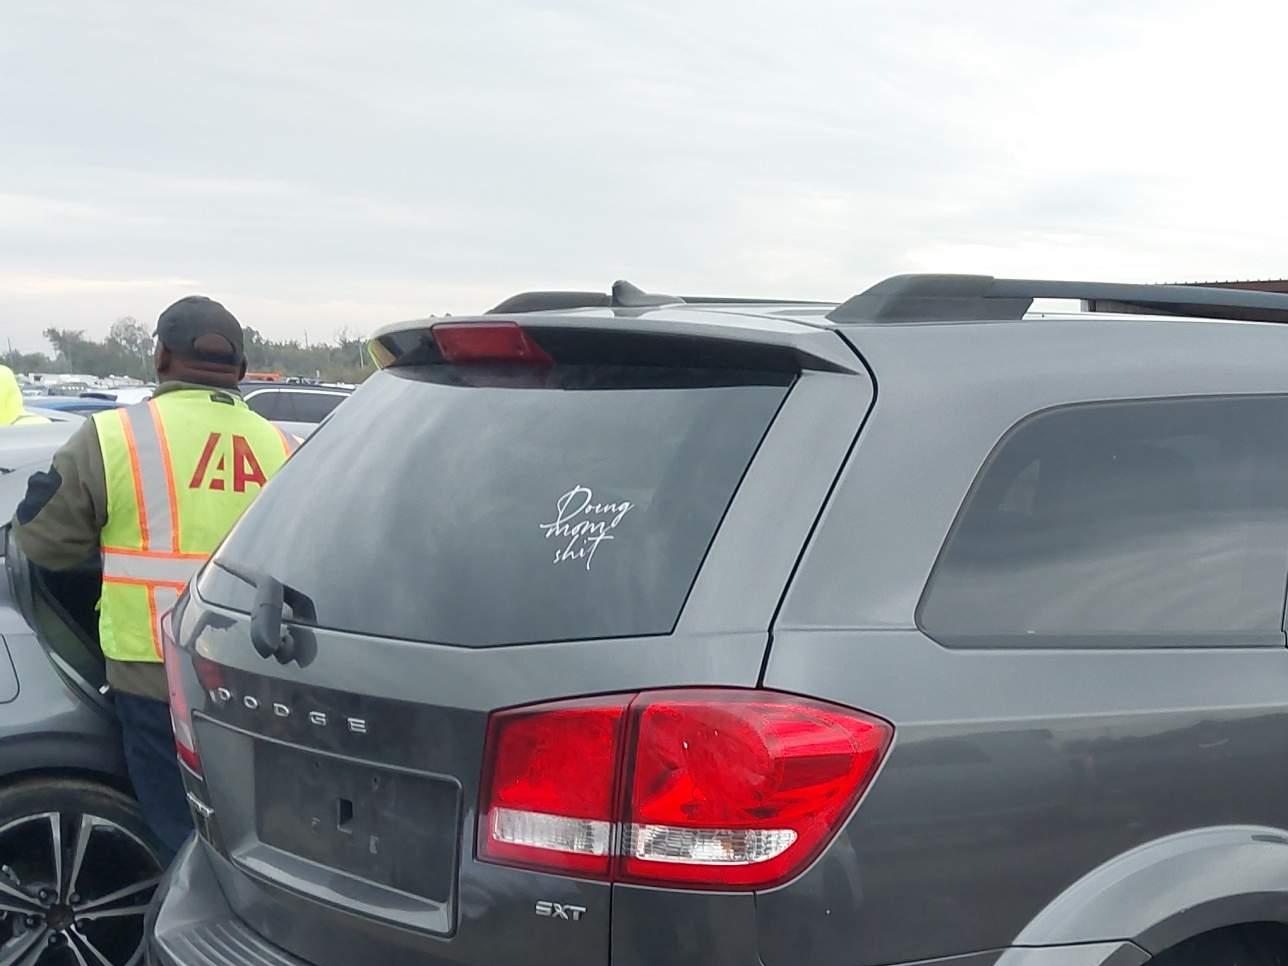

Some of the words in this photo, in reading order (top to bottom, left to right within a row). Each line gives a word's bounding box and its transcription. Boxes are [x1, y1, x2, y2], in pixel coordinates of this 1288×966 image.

[545, 520, 606, 538] mom
[553, 534, 614, 570] shit
[208, 687, 368, 733] DODGE
[535, 900, 587, 920] SXT
